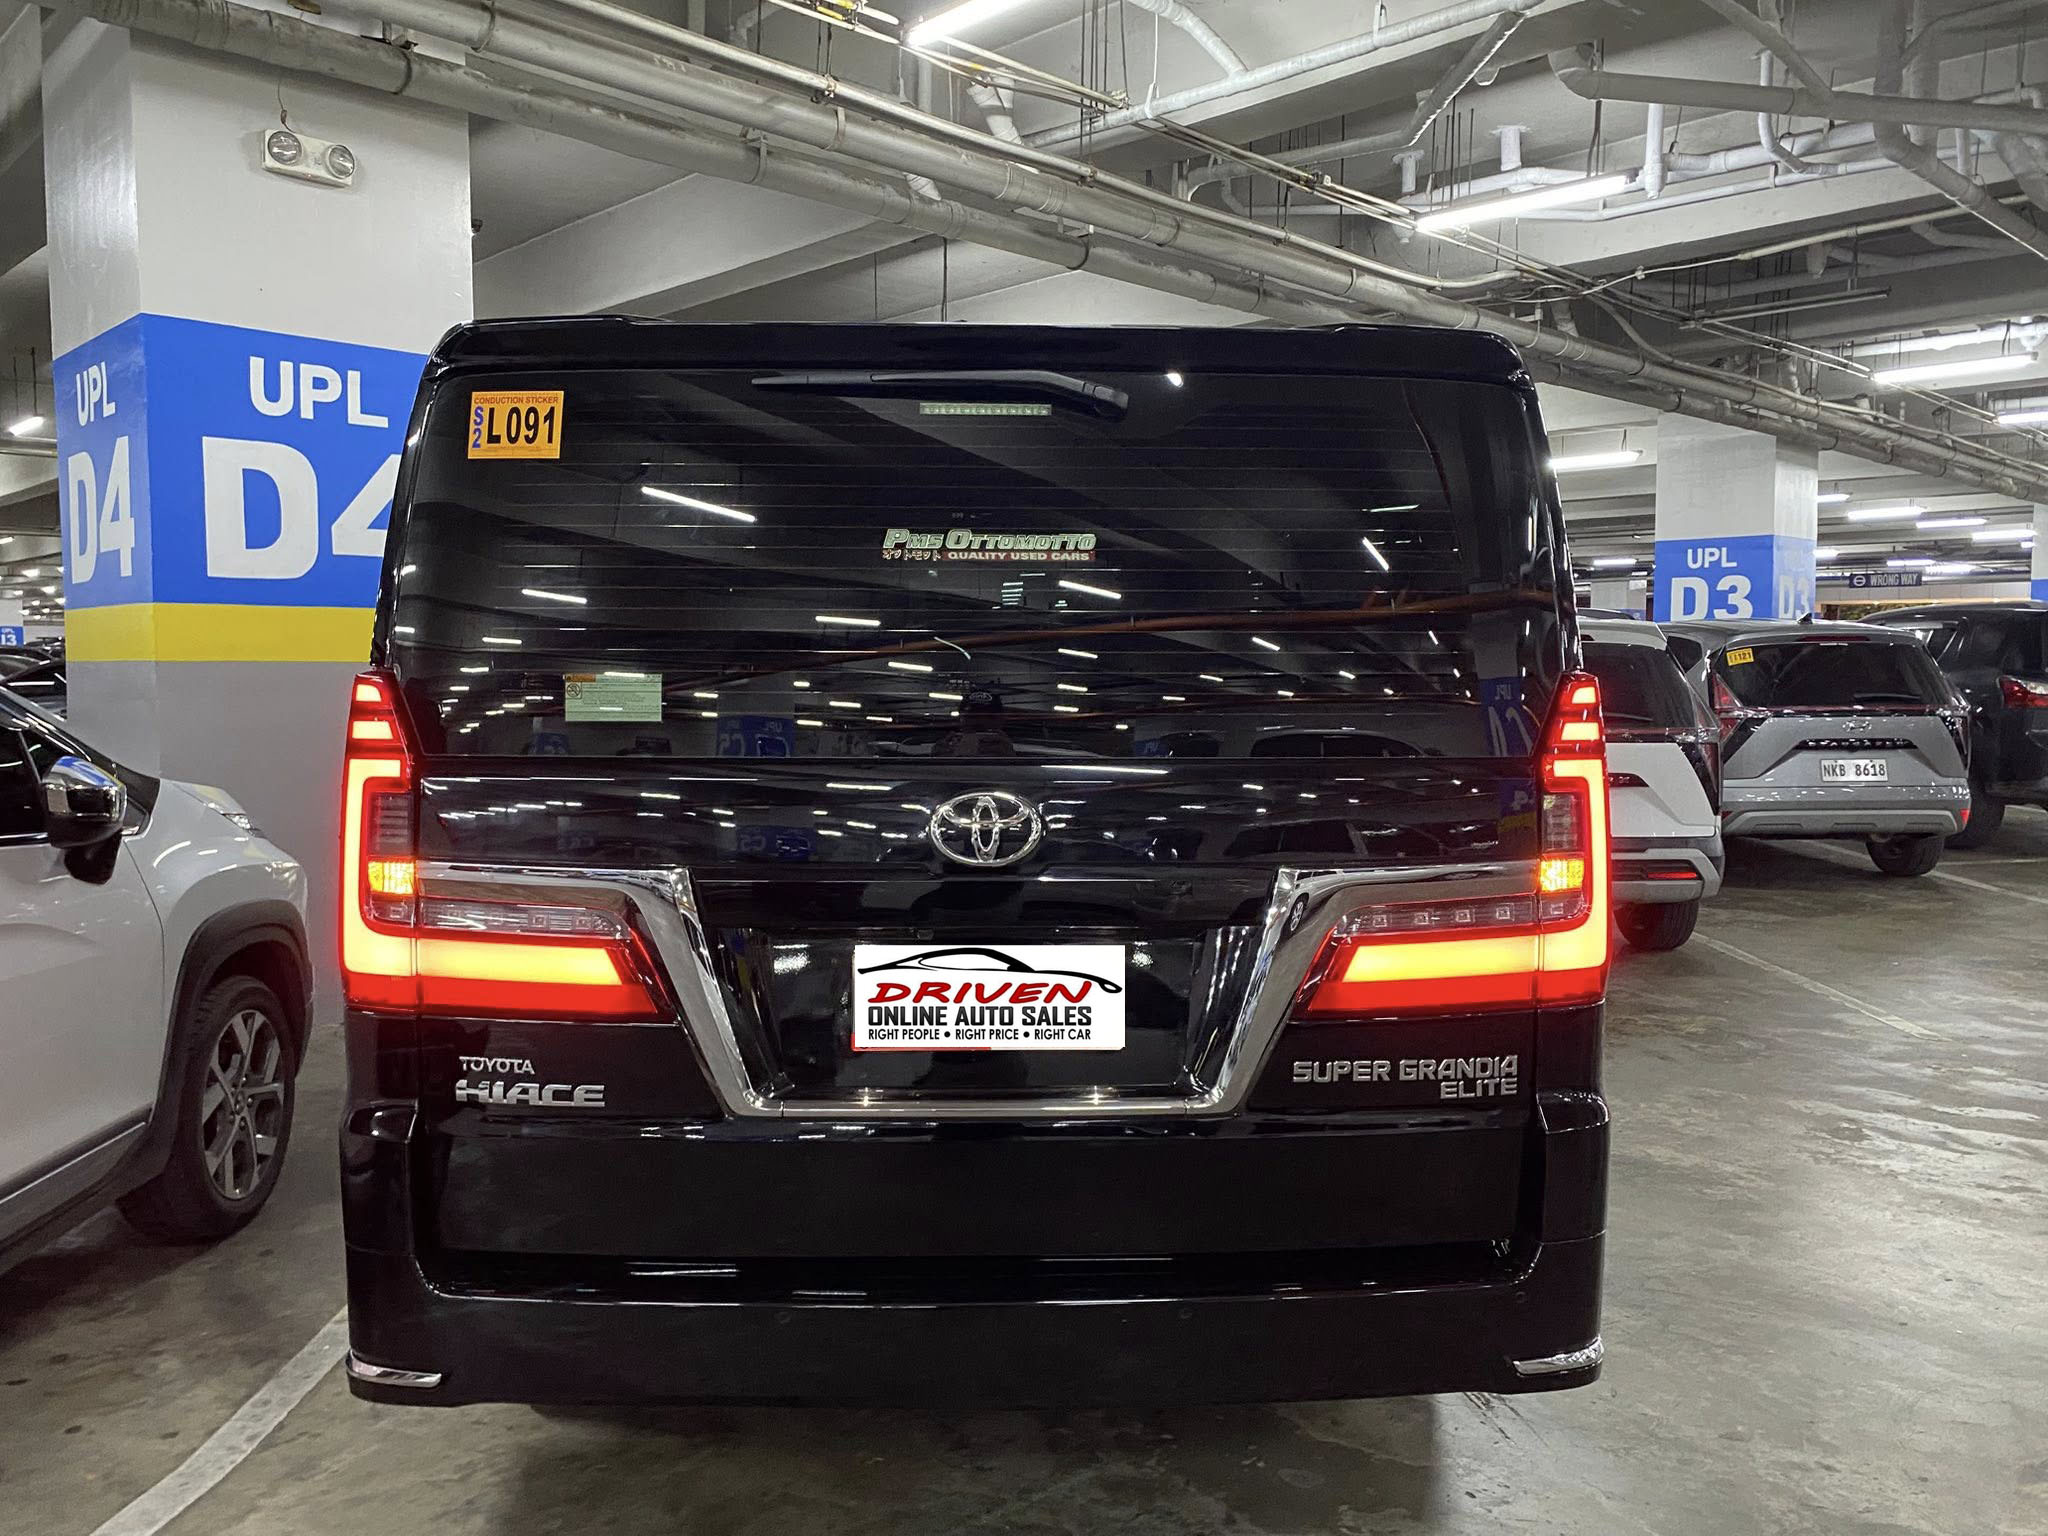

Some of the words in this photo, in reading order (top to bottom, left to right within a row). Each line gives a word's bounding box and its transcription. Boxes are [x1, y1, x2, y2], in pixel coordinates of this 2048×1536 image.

[76, 362, 116, 426] UPL
[249, 355, 389, 428] UPL
[474, 396, 523, 405] CONDUCTION
[525, 396, 559, 404] STICKER
[487, 406, 556, 444] L091
[68, 435, 135, 584] D4
[948, 551, 1006, 560] QUALITY
[1010, 551, 1048, 560] USED
[1051, 550, 1090, 560] CARS
[1687, 547, 1738, 569] UPL
[1871, 574, 1899, 586] WRONG
[1900, 573, 1918, 585] WAY
[1670, 575, 1753, 622] D3
[1823, 764, 1846, 776] NKB
[1855, 764, 1886, 776] 8618
[459, 1056, 535, 1074] TOYOTA
[1293, 1060, 1391, 1083] SUPER
[1399, 1055, 1518, 1081] GRANDIA
[455, 1079, 605, 1107] HIACE
[1440, 1078, 1518, 1099] ELITE
